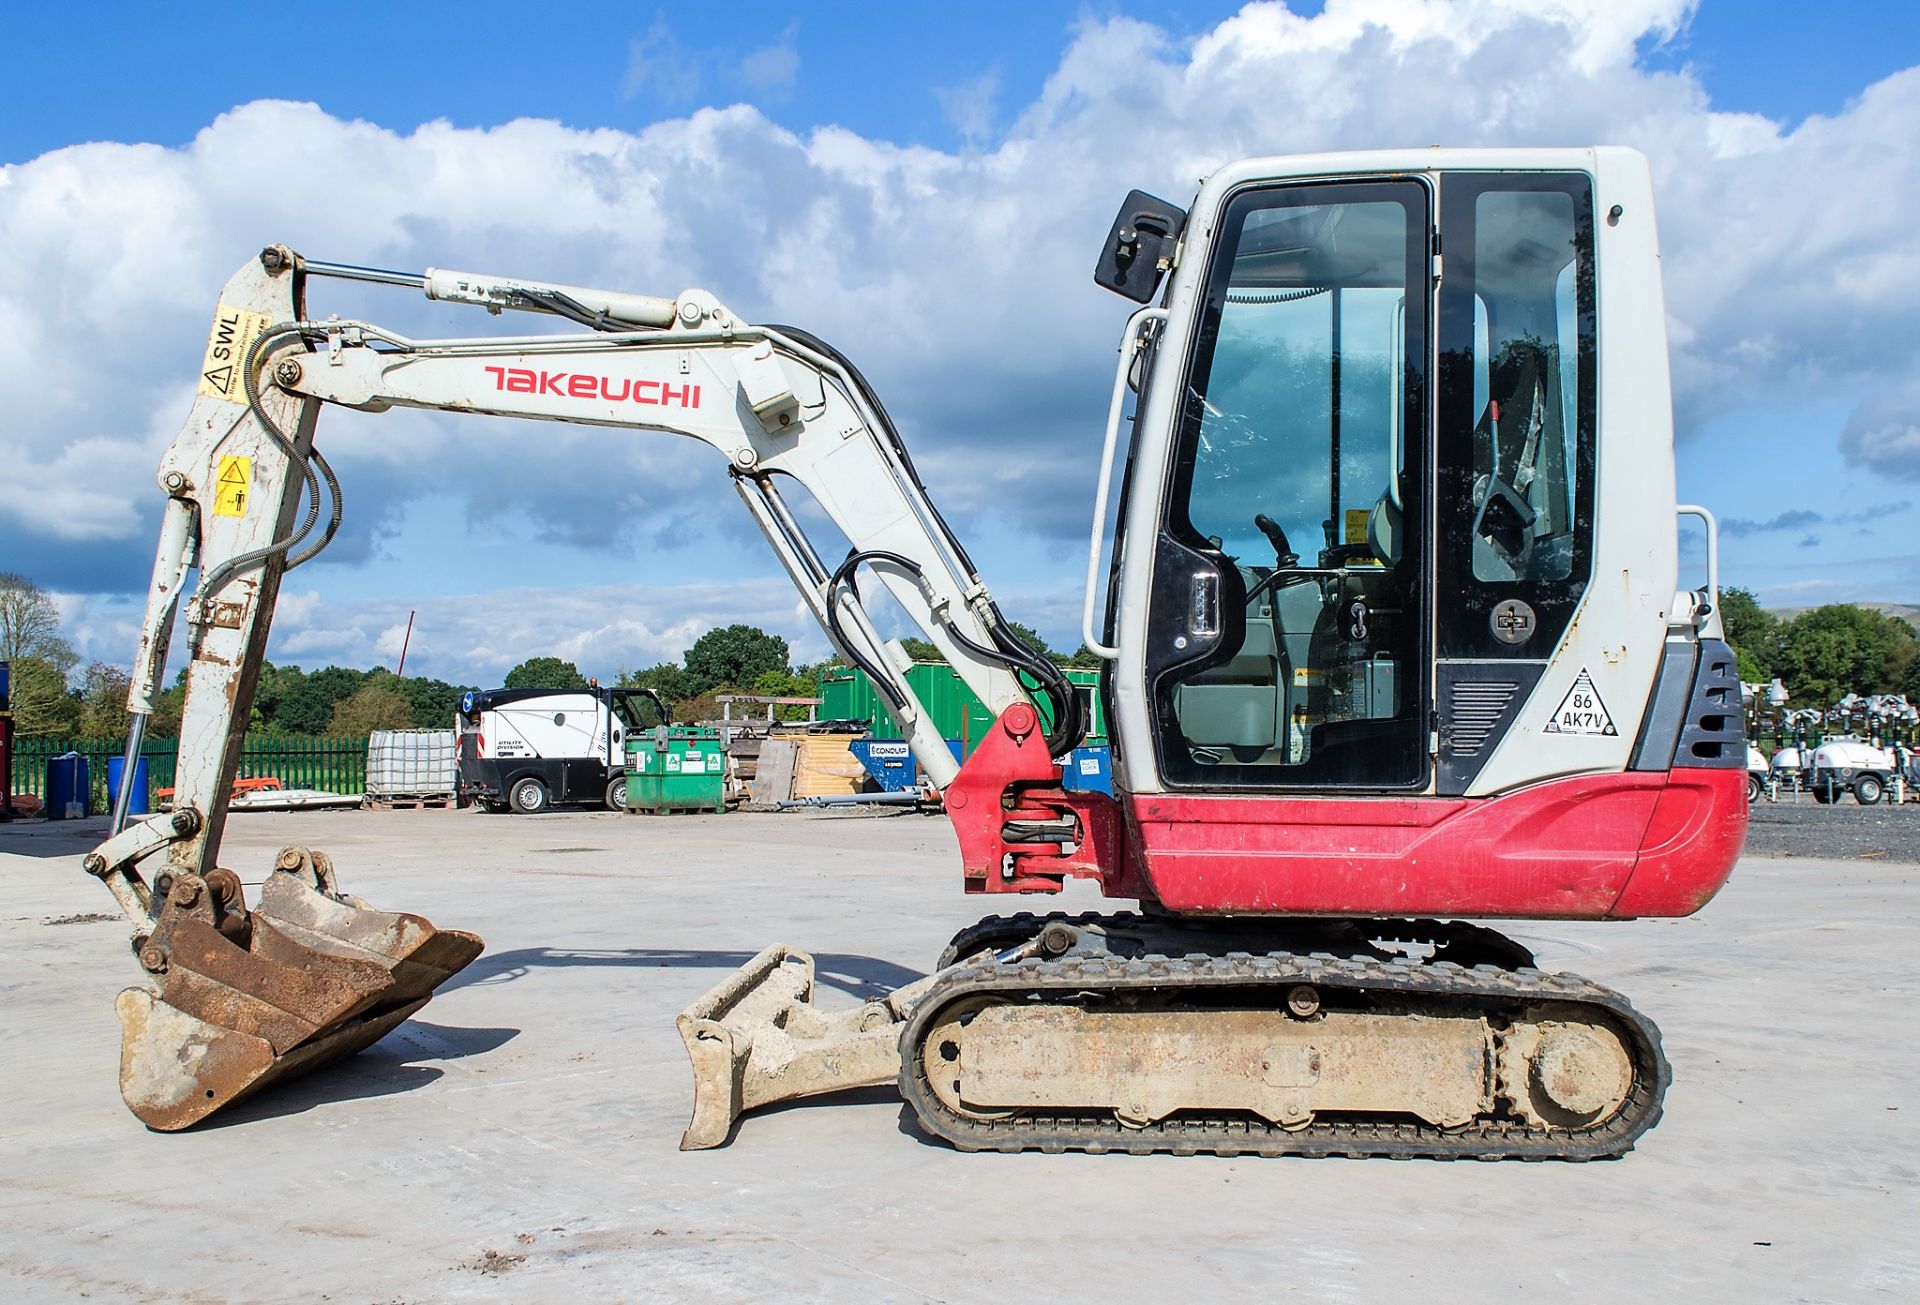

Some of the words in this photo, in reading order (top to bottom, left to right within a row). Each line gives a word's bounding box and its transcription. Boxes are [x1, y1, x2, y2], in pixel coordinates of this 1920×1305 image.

[214, 314, 239, 360] SWL
[229, 376, 237, 395] Refer
[1573, 694, 1592, 708] 86
[1563, 712, 1603, 727] AK7V
